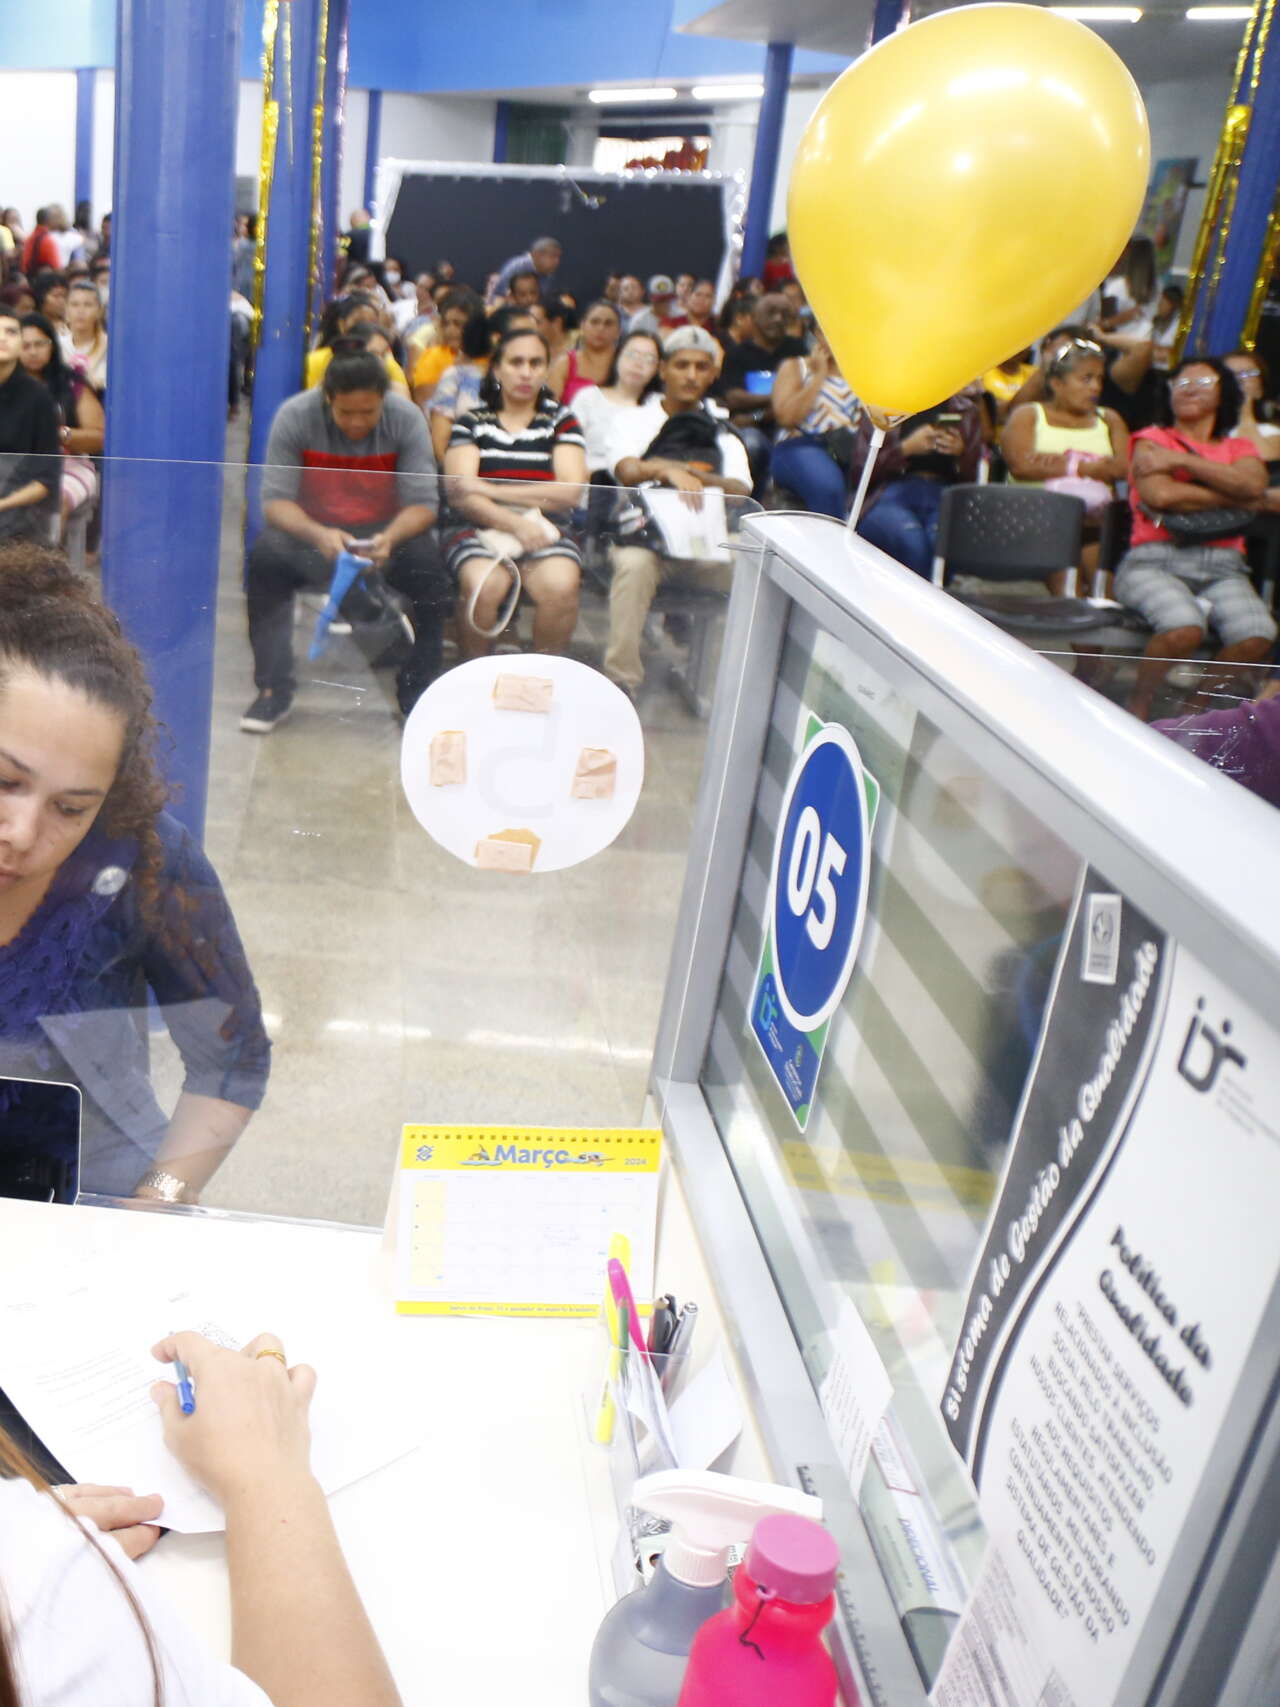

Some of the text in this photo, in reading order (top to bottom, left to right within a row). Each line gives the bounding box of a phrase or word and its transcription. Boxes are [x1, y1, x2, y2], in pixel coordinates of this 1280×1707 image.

[787, 805, 848, 951] 05
[494, 1144, 570, 1168] Março
[944, 1294, 993, 1422] Sistema
[990, 1253, 1011, 1297] de
[1008, 1162, 1061, 1264] Gestão
[1058, 1118, 1084, 1168] da
[1078, 940, 1158, 1123] Qualidade
[1048, 1355, 1088, 1428] BUSCANDO
[1055, 1301, 1111, 1399] RELACIONADOS
[1080, 1375, 1100, 1413] PELO
[1099, 1268, 1194, 1409] Qualidade
[1180, 1322, 1212, 1372] da
[1030, 1354, 1057, 1407] NOSSOS
[1099, 1472, 1156, 1566] ATENDENDO
[1006, 1475, 1099, 1644] SISTEMA DE GESTÃO DA
[1010, 1447, 1115, 1633] CONTINUAMENTE O NOSSO
[1066, 1516, 1130, 1627] MELHORANDO
